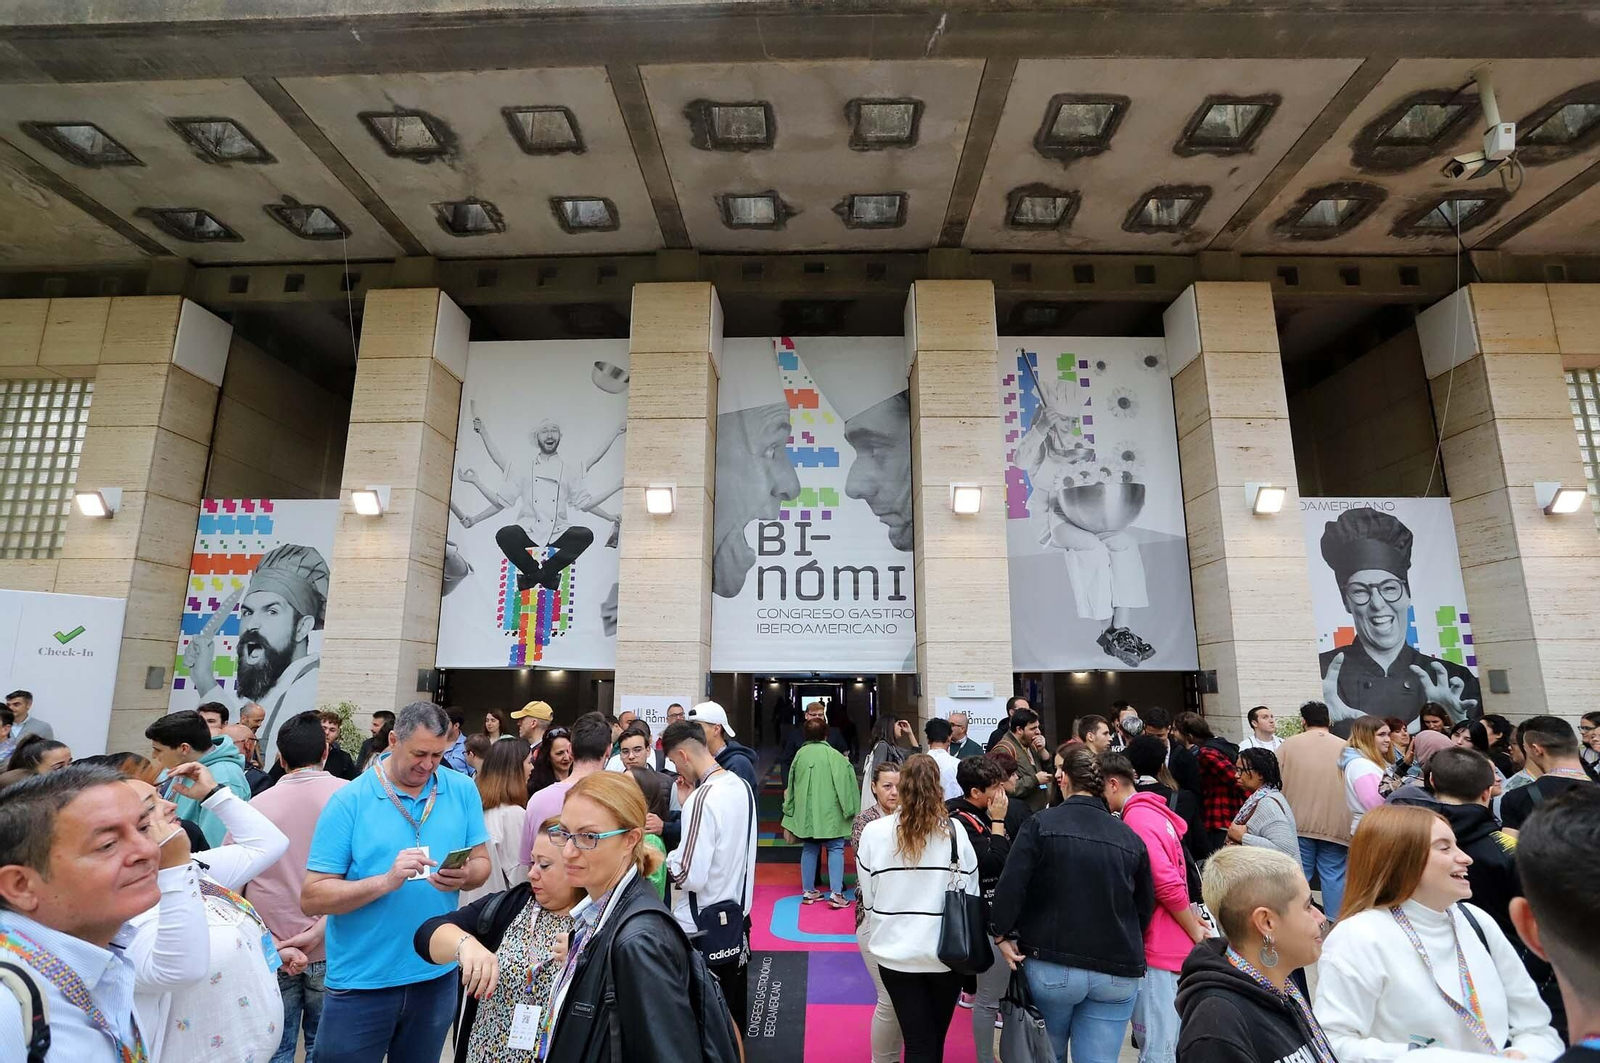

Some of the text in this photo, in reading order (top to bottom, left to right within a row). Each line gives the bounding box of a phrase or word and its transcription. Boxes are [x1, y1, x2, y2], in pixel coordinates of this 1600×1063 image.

[757, 521, 831, 557] BI-
[756, 608, 915, 619] CONGRESO GASTRO
[756, 623, 898, 635] IBEROAMERICANO
[38, 647, 93, 657] Check-In
[968, 717, 998, 725] ómico
[708, 944, 741, 961] adidas
[763, 980, 782, 1038] IBEROAMERICANO
[747, 1000, 765, 1038] CONGRESO
